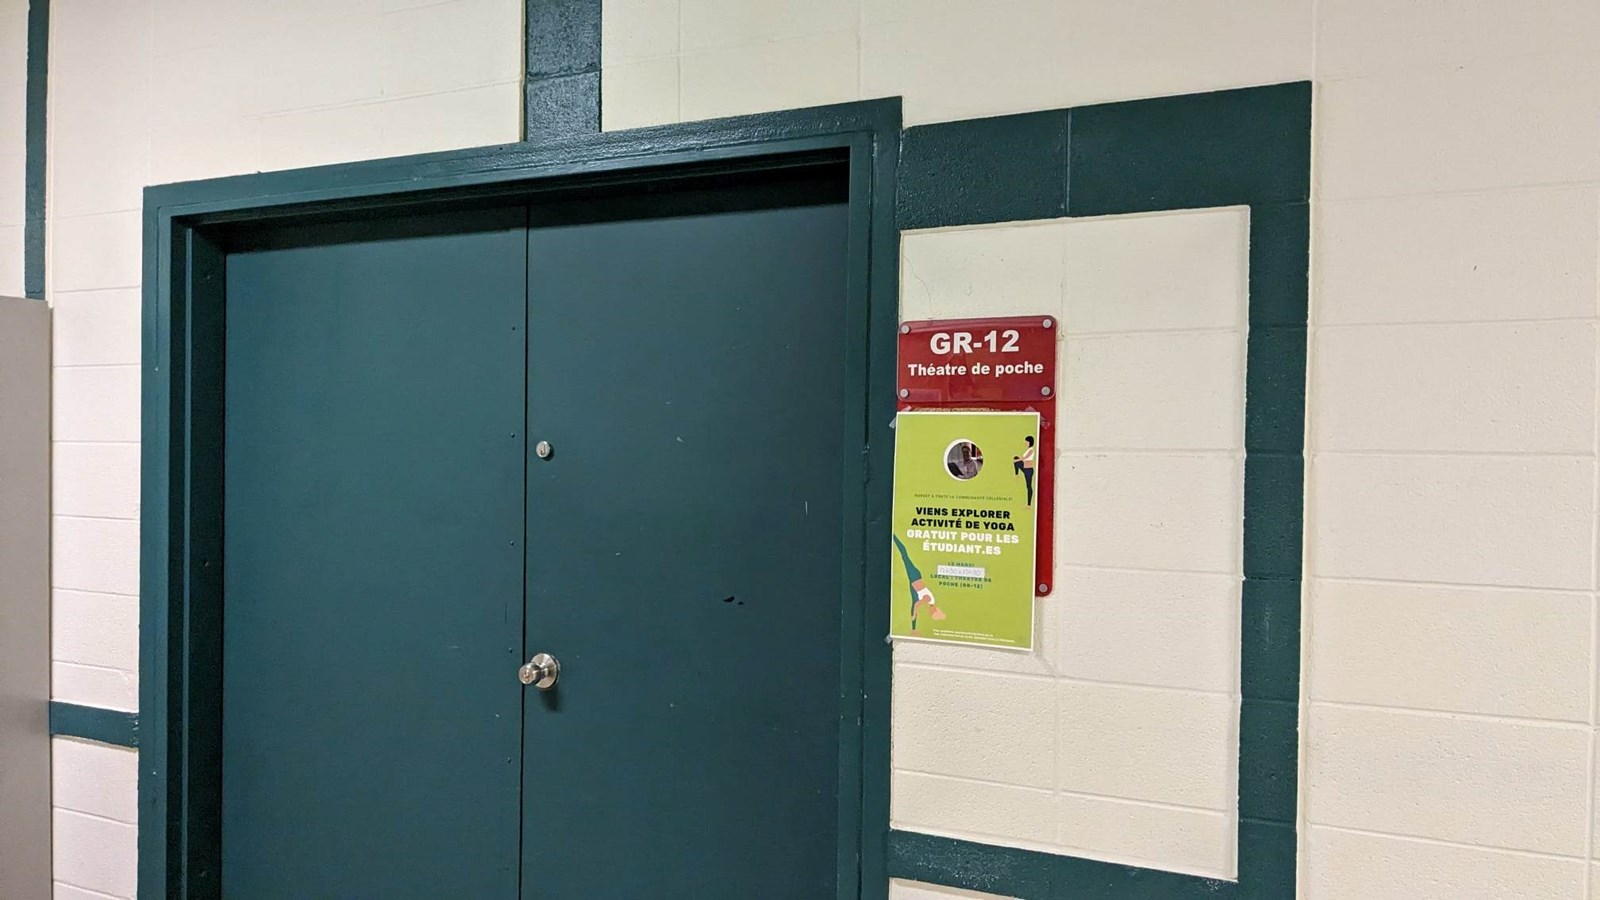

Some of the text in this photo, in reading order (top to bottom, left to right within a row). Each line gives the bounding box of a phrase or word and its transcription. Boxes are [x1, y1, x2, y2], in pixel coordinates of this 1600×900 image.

[930, 330, 1020, 355] GR-12
[908, 361, 1044, 377] Théatre de poche
[916, 507, 1010, 519] VIENS EXPLORER
[911, 518, 1015, 531] ACTIVITÉ DE YOGA
[906, 529, 1020, 543] GRATUIT POUR LES
[922, 540, 1001, 555] ÉTUDIANT.ES
